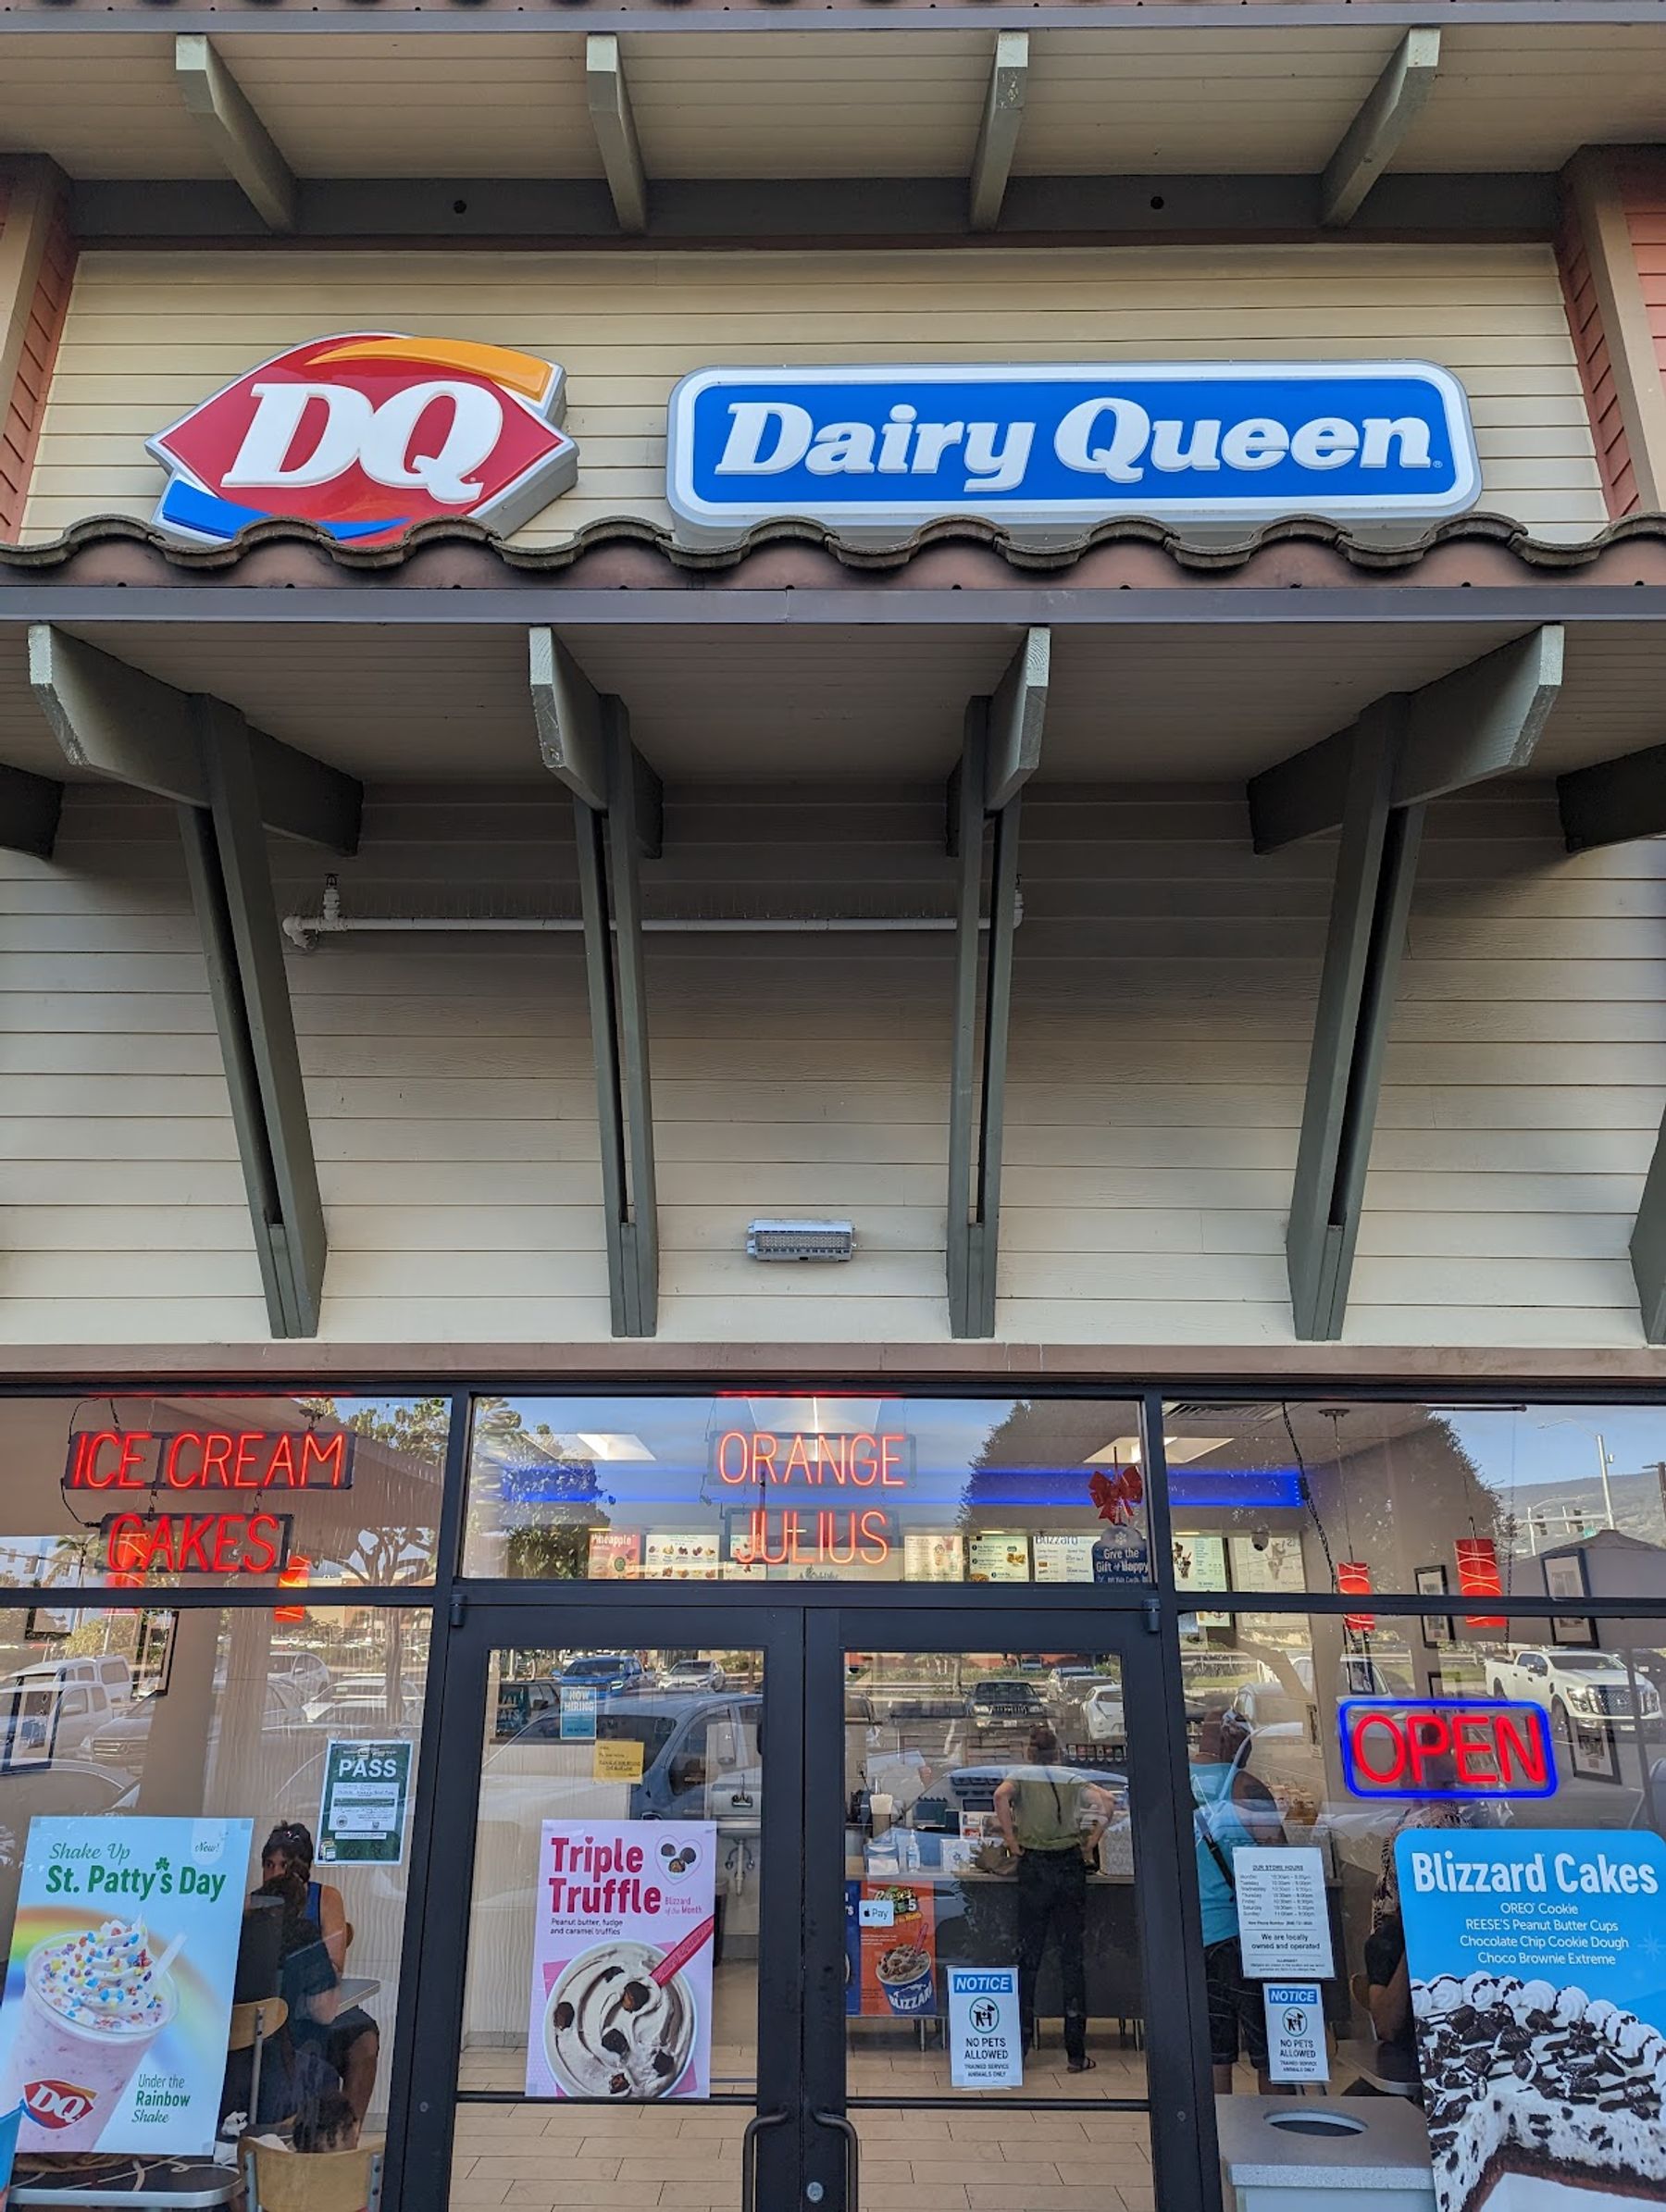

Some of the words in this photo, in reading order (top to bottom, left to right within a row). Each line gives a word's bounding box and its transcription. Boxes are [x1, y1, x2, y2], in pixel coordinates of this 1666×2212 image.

[220, 380, 503, 504] DQ
[715, 401, 1036, 492] Dairy
[1054, 396, 1434, 483] Queen
[73, 1432, 151, 1489] ICE
[167, 1432, 346, 1489] CREAM
[718, 1431, 906, 1486] ORANGE
[107, 1512, 279, 1572] CAKES
[735, 1510, 889, 1565] JULIUS
[569, 1690, 591, 1701] NOW
[564, 1701, 594, 1711] HIRING
[1351, 1713, 1547, 1783] OPEN
[339, 1758, 397, 1777] PASS
[49, 1843, 102, 1859] Shake
[107, 1843, 131, 1866] Up
[551, 1836, 643, 1883] Triple
[1411, 1851, 1546, 1893] Blizzard
[1554, 1853, 1659, 1894] Cakes
[45, 1865, 81, 1894] St.
[179, 1866, 227, 1903] Day
[549, 1878, 661, 1915] Truffle
[872, 1908, 889, 1920] Pay
[1500, 1902, 1533, 1914] OREO
[1538, 1903, 1579, 1915] Cookie
[551, 1918, 576, 1926] Peanut
[603, 1918, 623, 1928] fudge
[1466, 1919, 1511, 1931] REESE'S
[1513, 1919, 1550, 1931] Peanut
[1554, 1920, 1587, 1931] Butter
[1590, 1920, 1619, 1932] Cups
[1460, 1935, 1518, 1947] Chocolate
[1519, 1935, 1546, 1949] Chip
[1548, 1935, 1588, 1948] Cookie
[1591, 1936, 1629, 1951] Dough
[1478, 1952, 1516, 1964] Choco
[1519, 1952, 1566, 1964] Brownie
[1568, 1953, 1616, 1965] Extreme
[956, 1976, 1010, 1991] NOTICE
[1271, 1990, 1315, 2002] NOTICE
[965, 2037, 979, 2047] NO
[982, 2037, 1006, 2047] PETS
[1280, 2039, 1292, 2047] NO
[1293, 2039, 1314, 2048] PETS
[964, 2050, 1009, 2060] ALLOWED
[1280, 2049, 1316, 2058] ALLOWED
[138, 2074, 167, 2088] Under
[168, 2074, 185, 2089] the
[29, 2084, 86, 2124] DQ
[136, 2090, 191, 2107] Rainbow
[131, 2109, 170, 2124] Shake
